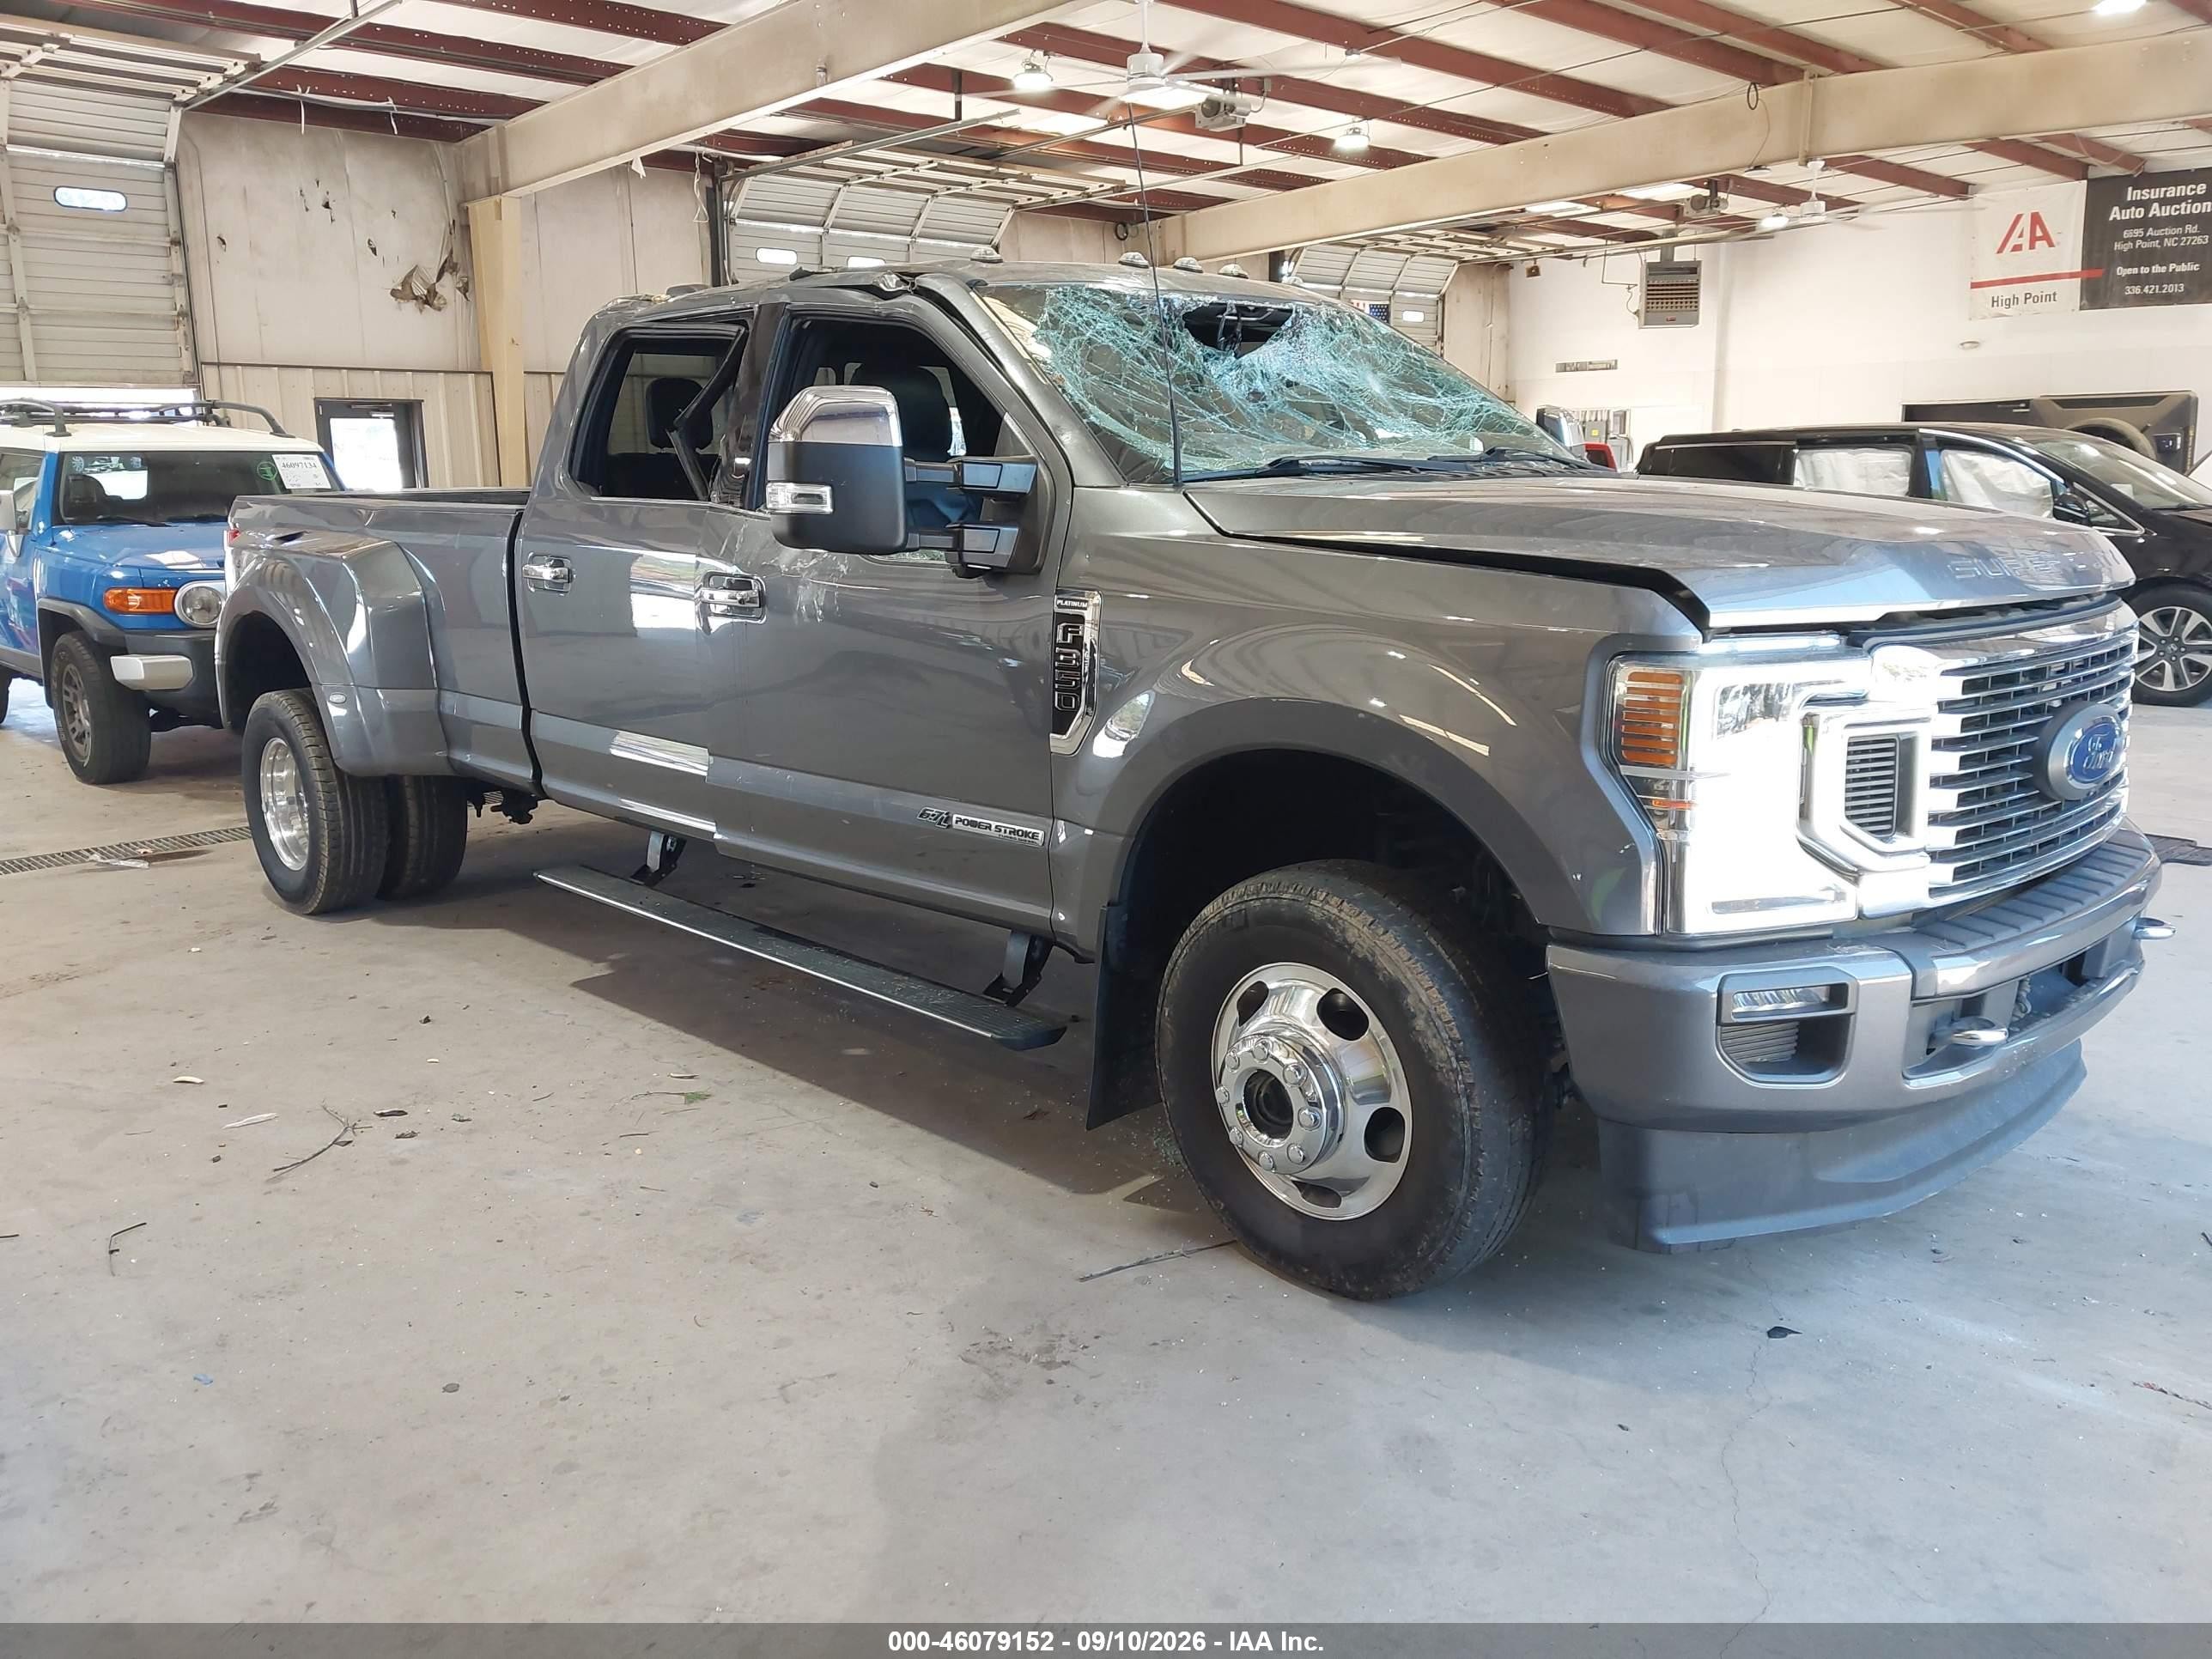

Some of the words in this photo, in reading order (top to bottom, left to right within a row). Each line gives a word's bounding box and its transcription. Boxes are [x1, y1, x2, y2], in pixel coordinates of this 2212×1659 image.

[2126, 183, 2207, 201] Insurance
[2108, 206, 2145, 221] Auto
[2148, 199, 2212, 217] Auction
[2146, 227, 2182, 237] Auction
[2185, 224, 2200, 234] Rd.
[2114, 241, 2133, 252] High
[2135, 239, 2161, 249] Point,
[2163, 237, 2179, 247] NC
[2180, 234, 2209, 246] 27263
[2117, 265, 2138, 276] Open
[2152, 264, 2166, 273] the
[2168, 262, 2200, 272] Public
[2124, 283, 2185, 295] 336.421.2013
[1991, 293, 2019, 309] High
[2024, 291, 2057, 305] Point
[1056, 599, 1088, 609] PLATINUM
[954, 817, 993, 831] POWER
[994, 824, 1040, 841] STROKE
